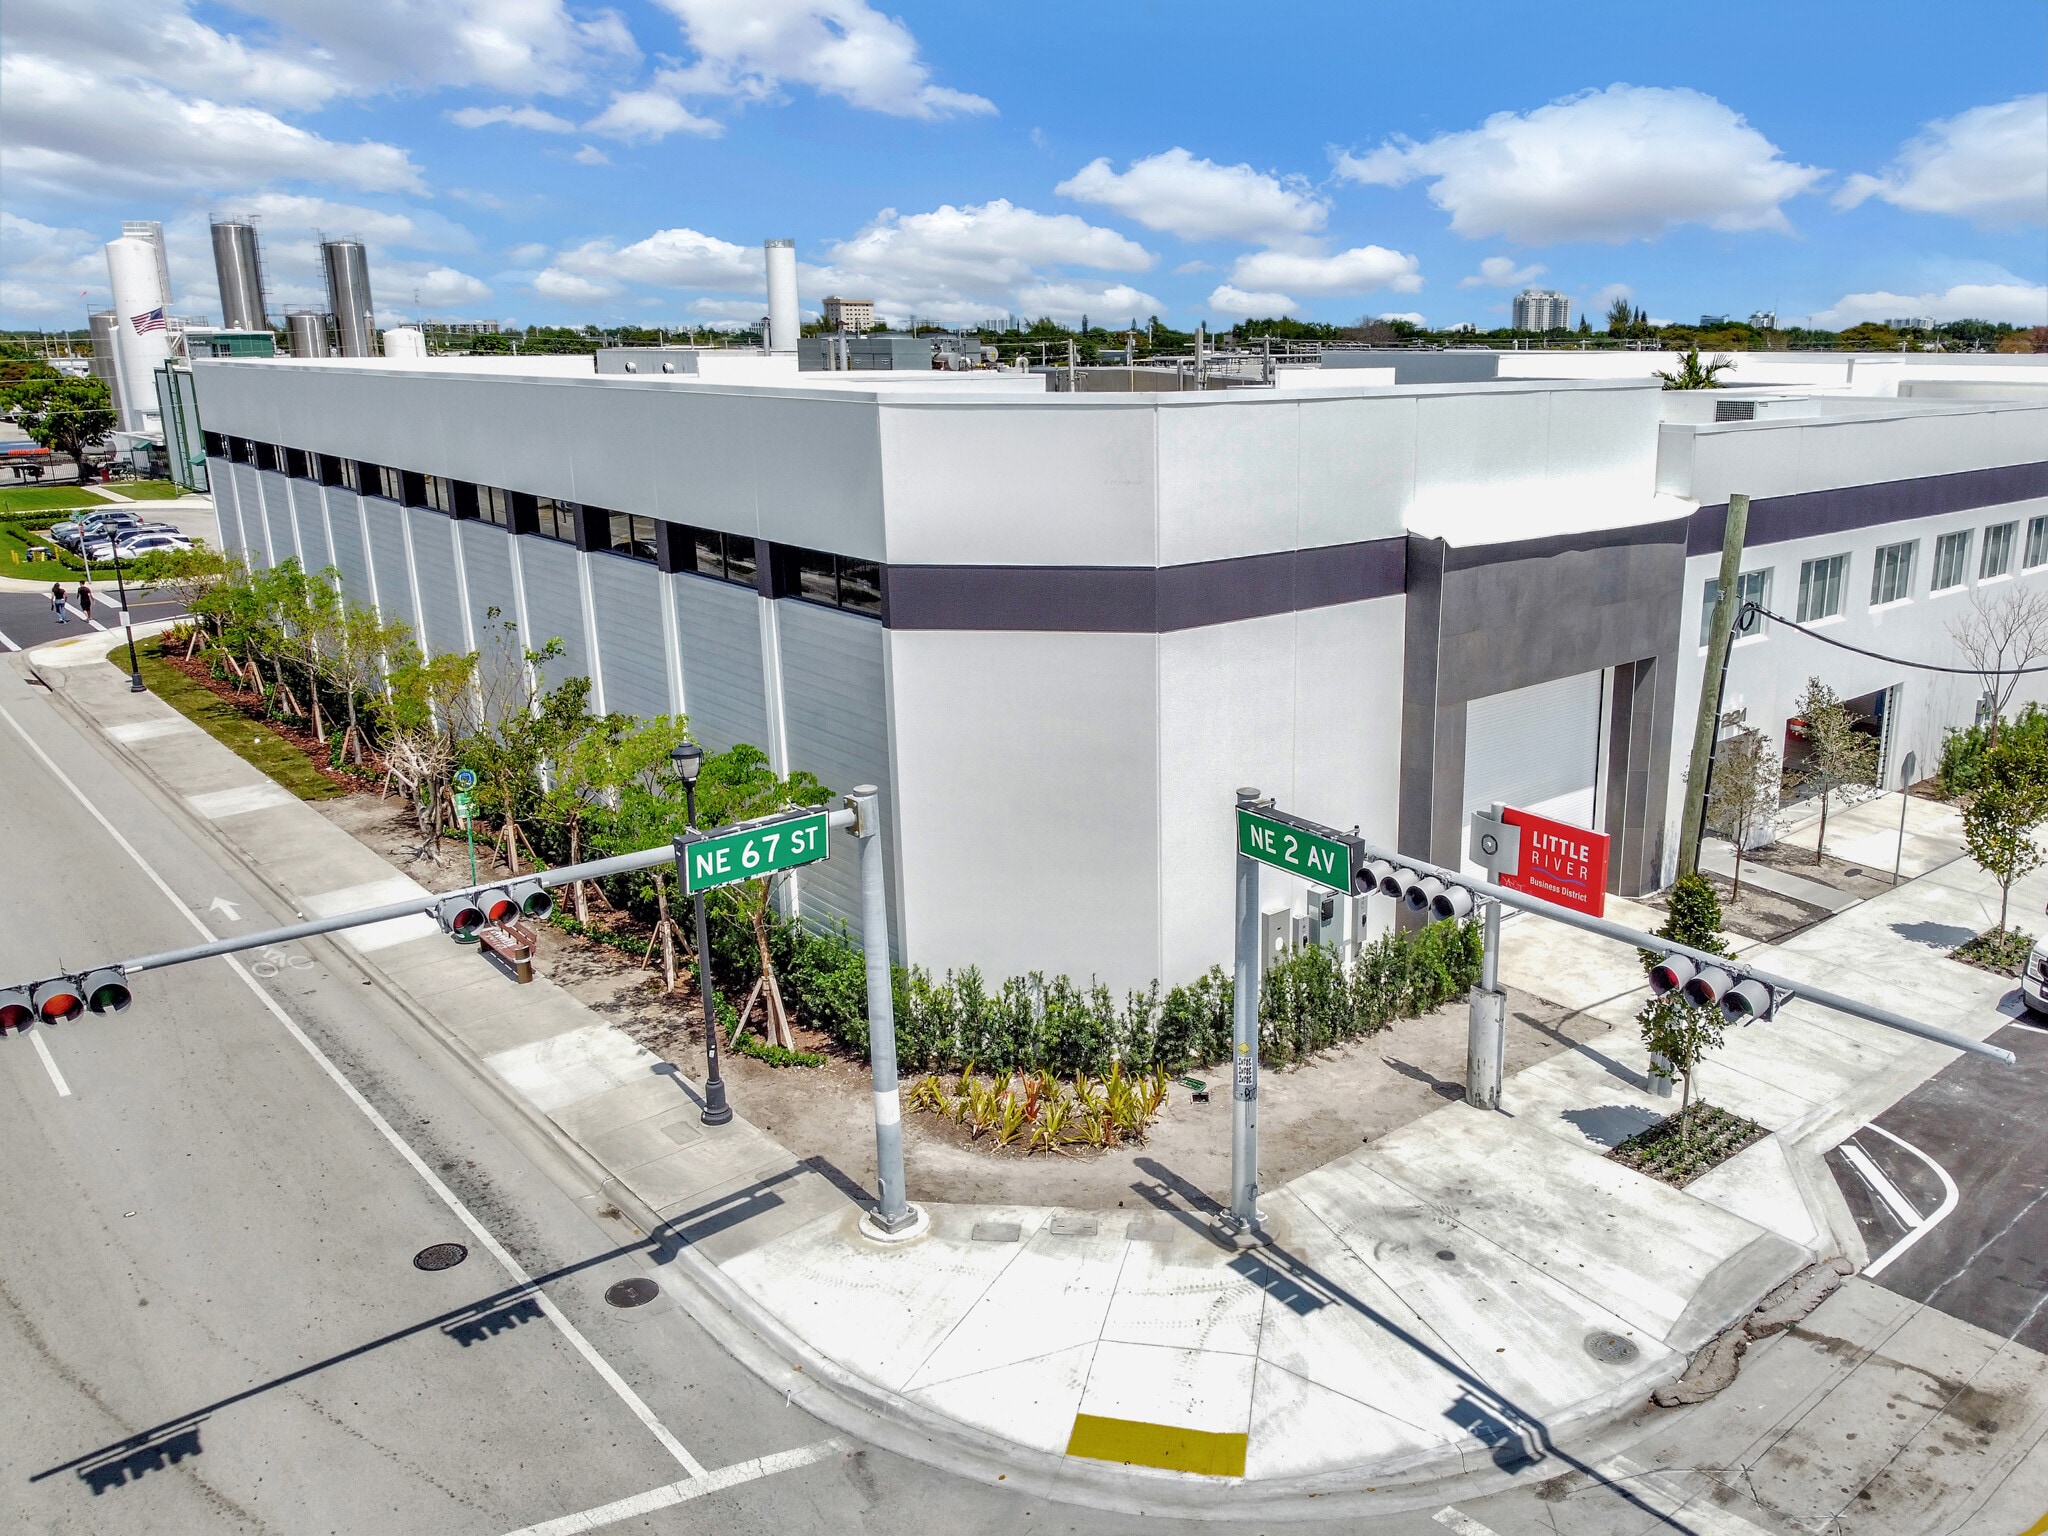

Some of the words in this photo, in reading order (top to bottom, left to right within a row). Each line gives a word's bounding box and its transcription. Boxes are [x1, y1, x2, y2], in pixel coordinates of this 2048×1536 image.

[697, 848, 731, 878] NE
[742, 833, 780, 868] 67
[791, 826, 818, 854] ST
[1250, 824, 1276, 854] NE
[1284, 835, 1299, 864] 2
[1307, 845, 1335, 874] AV
[1533, 830, 1589, 862] LITTLE
[1532, 851, 1587, 880] RIVER
[1530, 876, 1560, 893] Business
[1561, 886, 1587, 902] District
